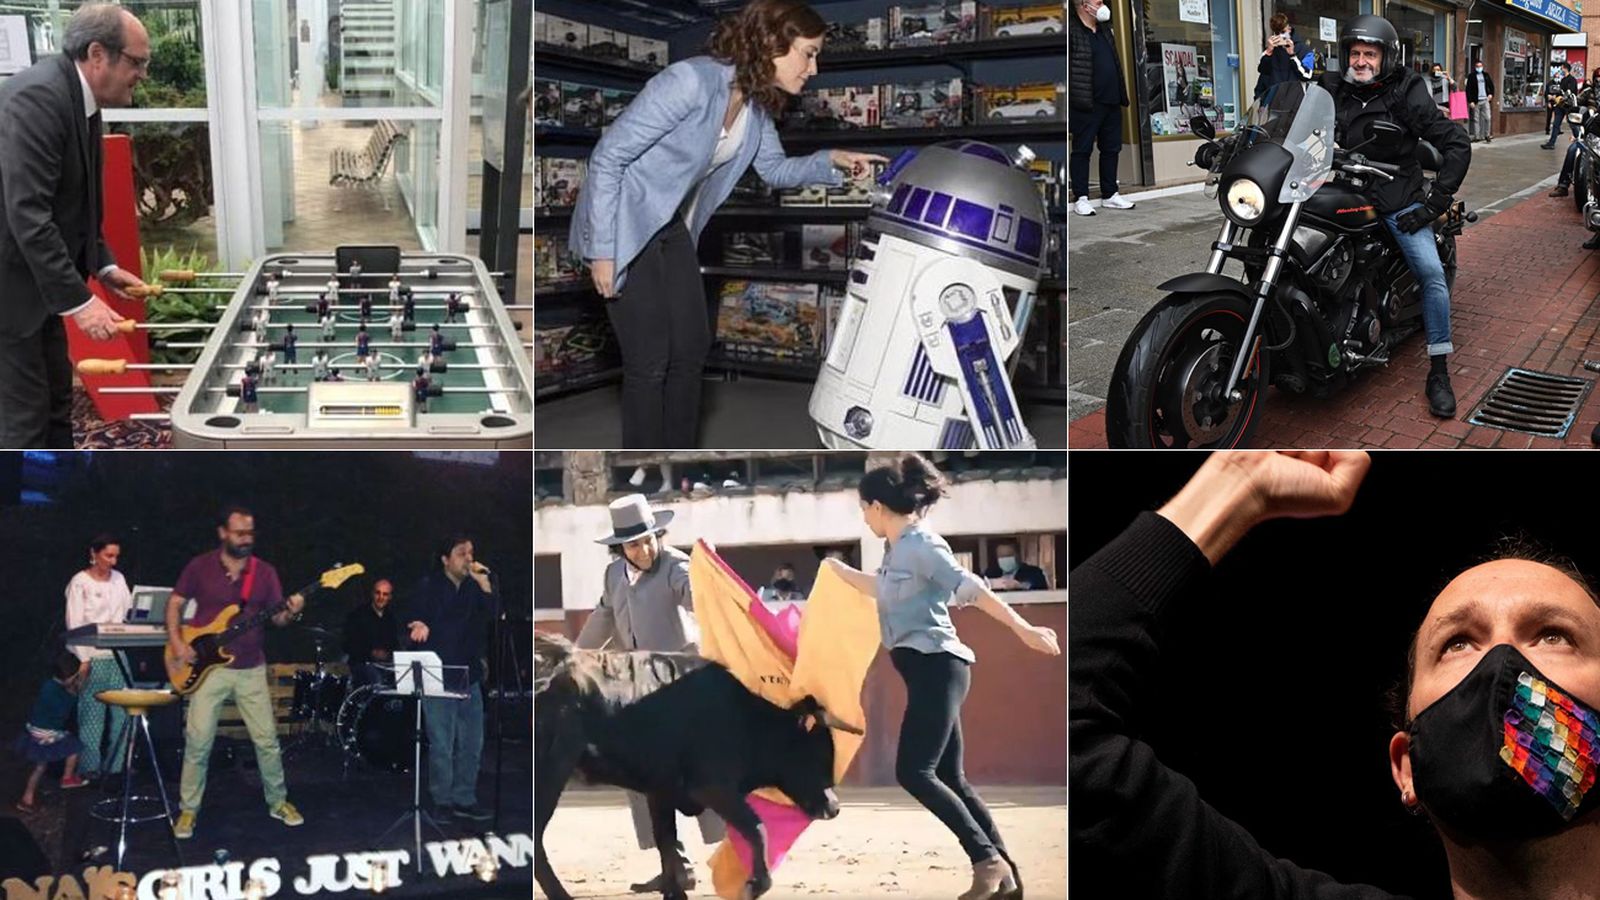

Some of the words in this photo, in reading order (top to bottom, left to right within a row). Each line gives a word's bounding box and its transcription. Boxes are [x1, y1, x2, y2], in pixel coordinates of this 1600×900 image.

[1164, 49, 1196, 67] SCANDAL
[137, 857, 281, 900] GIRLS
[294, 849, 411, 895] JUST
